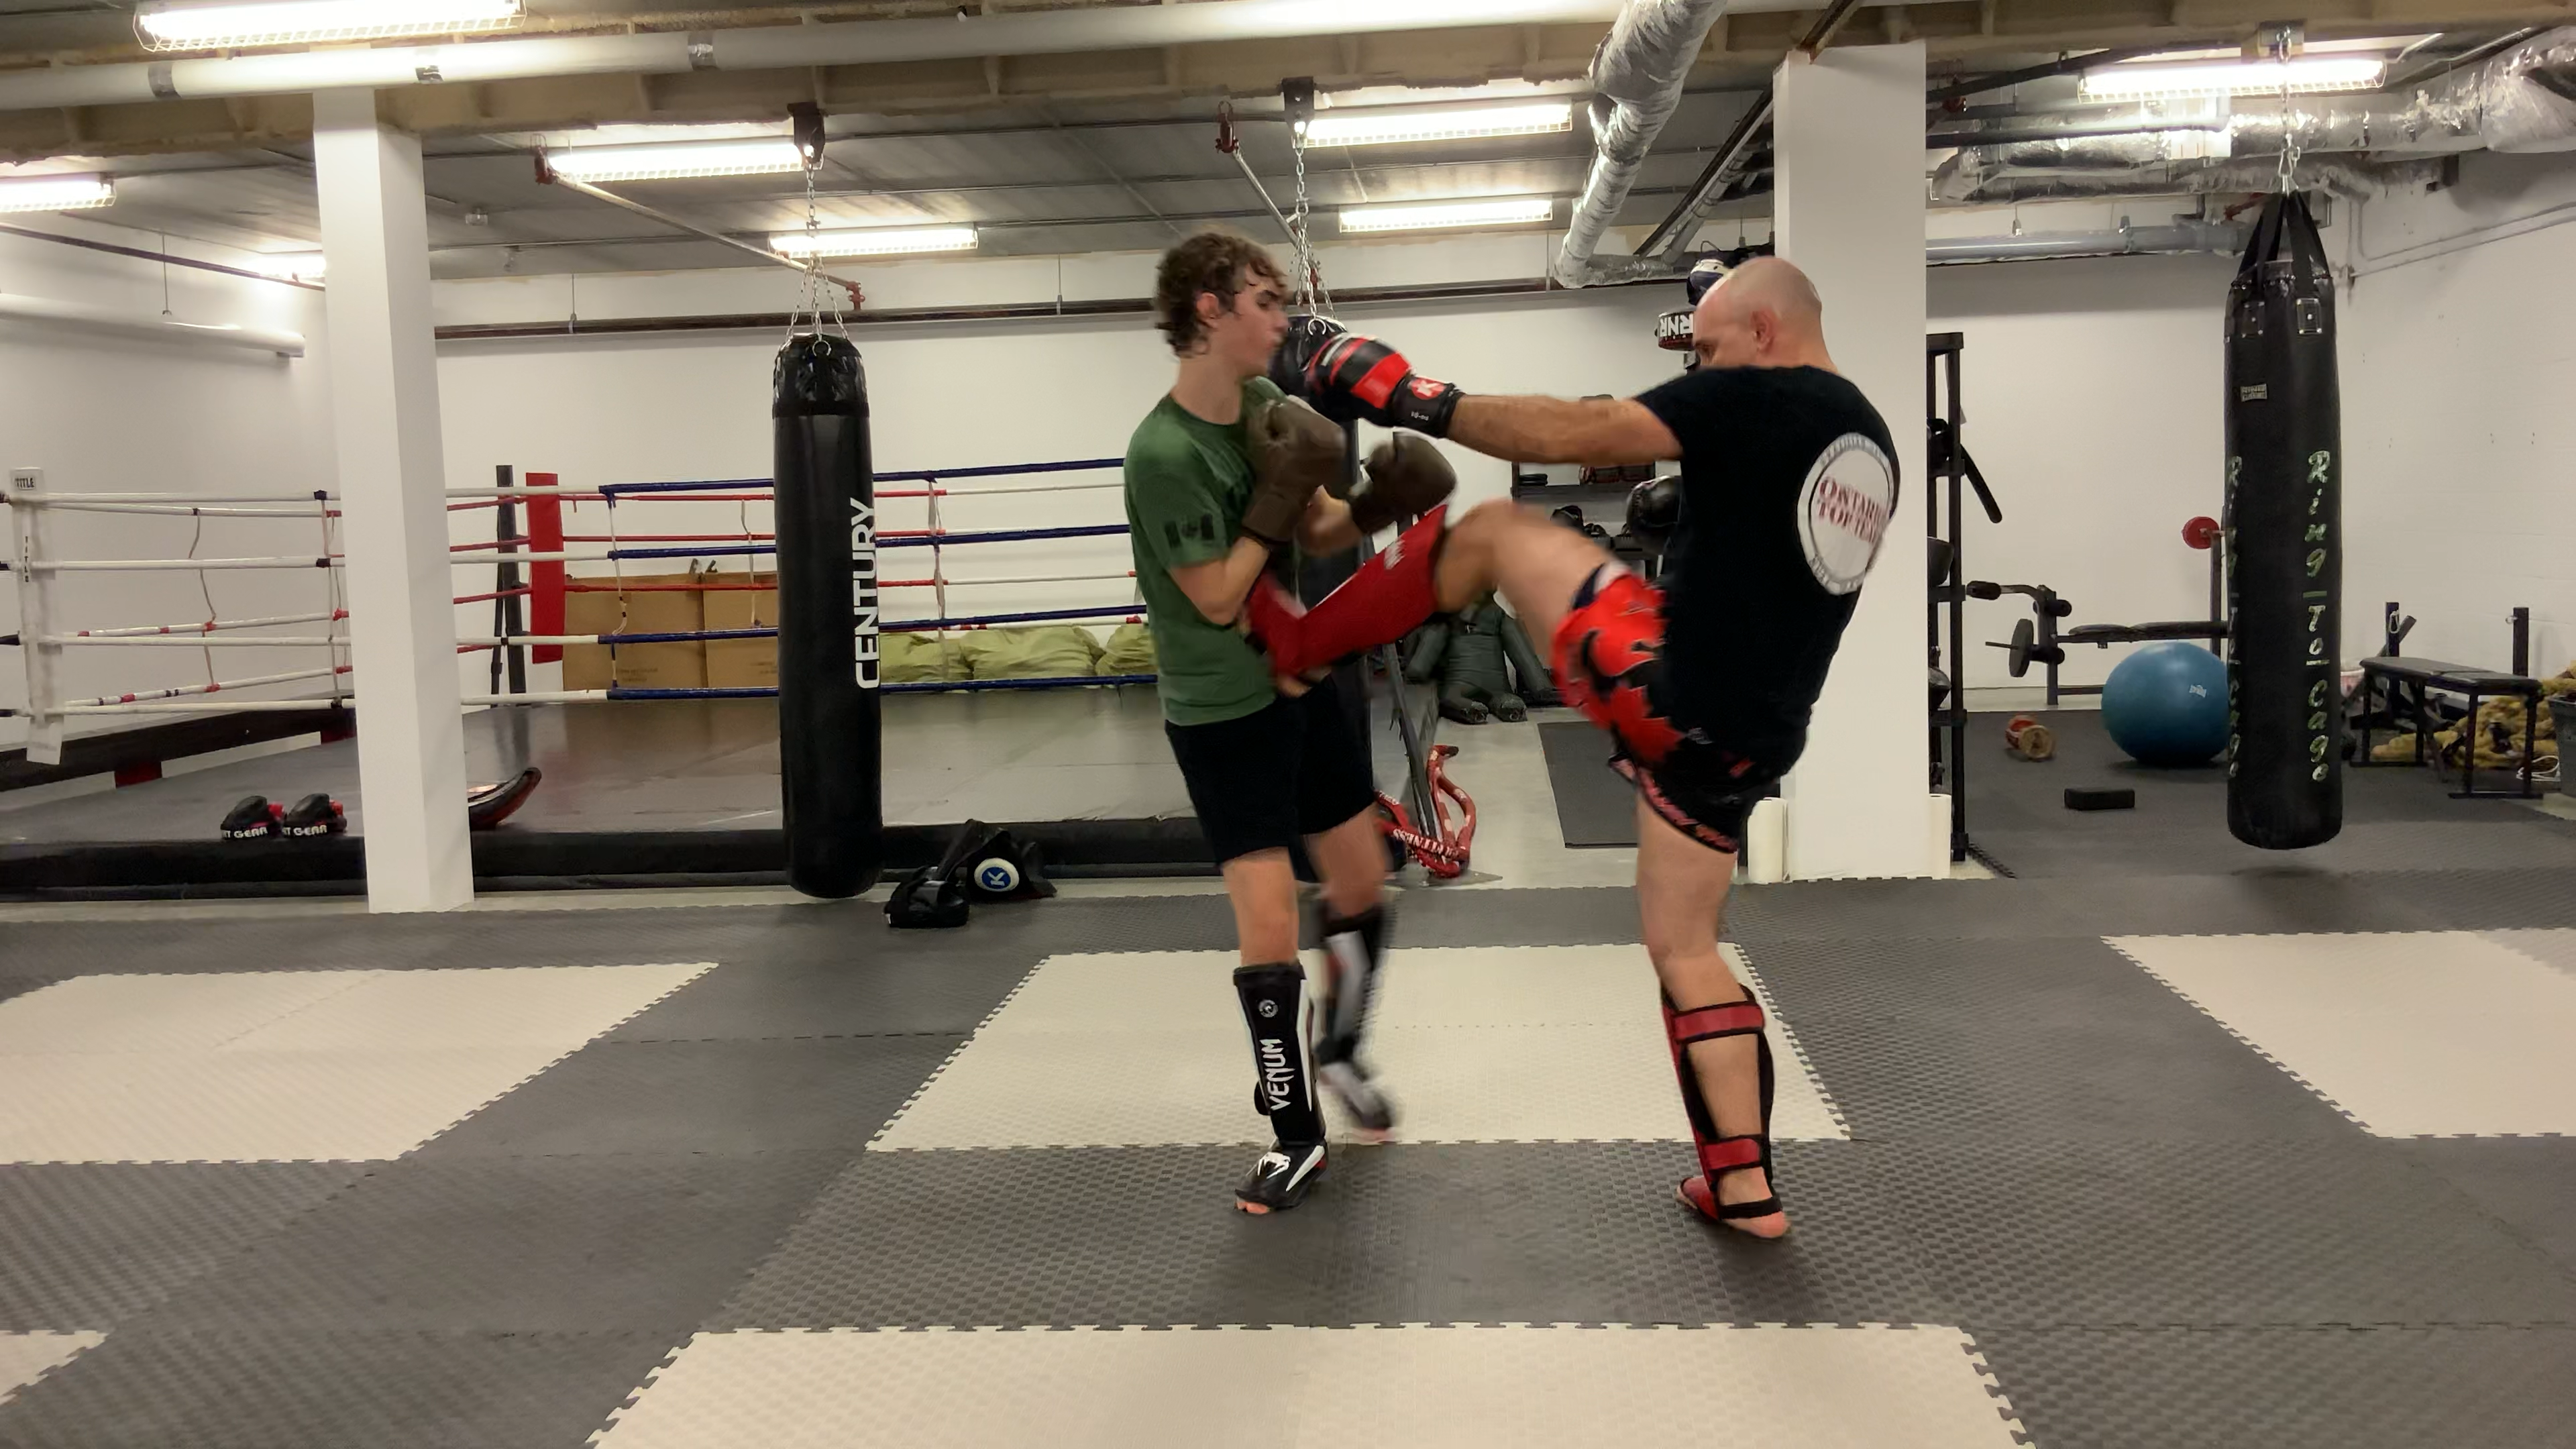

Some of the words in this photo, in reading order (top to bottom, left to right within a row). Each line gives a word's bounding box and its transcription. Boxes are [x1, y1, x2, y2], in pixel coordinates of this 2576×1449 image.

[1660, 313, 1693, 337] RNR
[15, 478, 34, 488] TITLE
[850, 497, 880, 689] CENTURY
[234, 826, 268, 838] GEAR
[293, 824, 327, 836] GEAR
[1259, 1039, 1295, 1110] VENUM
